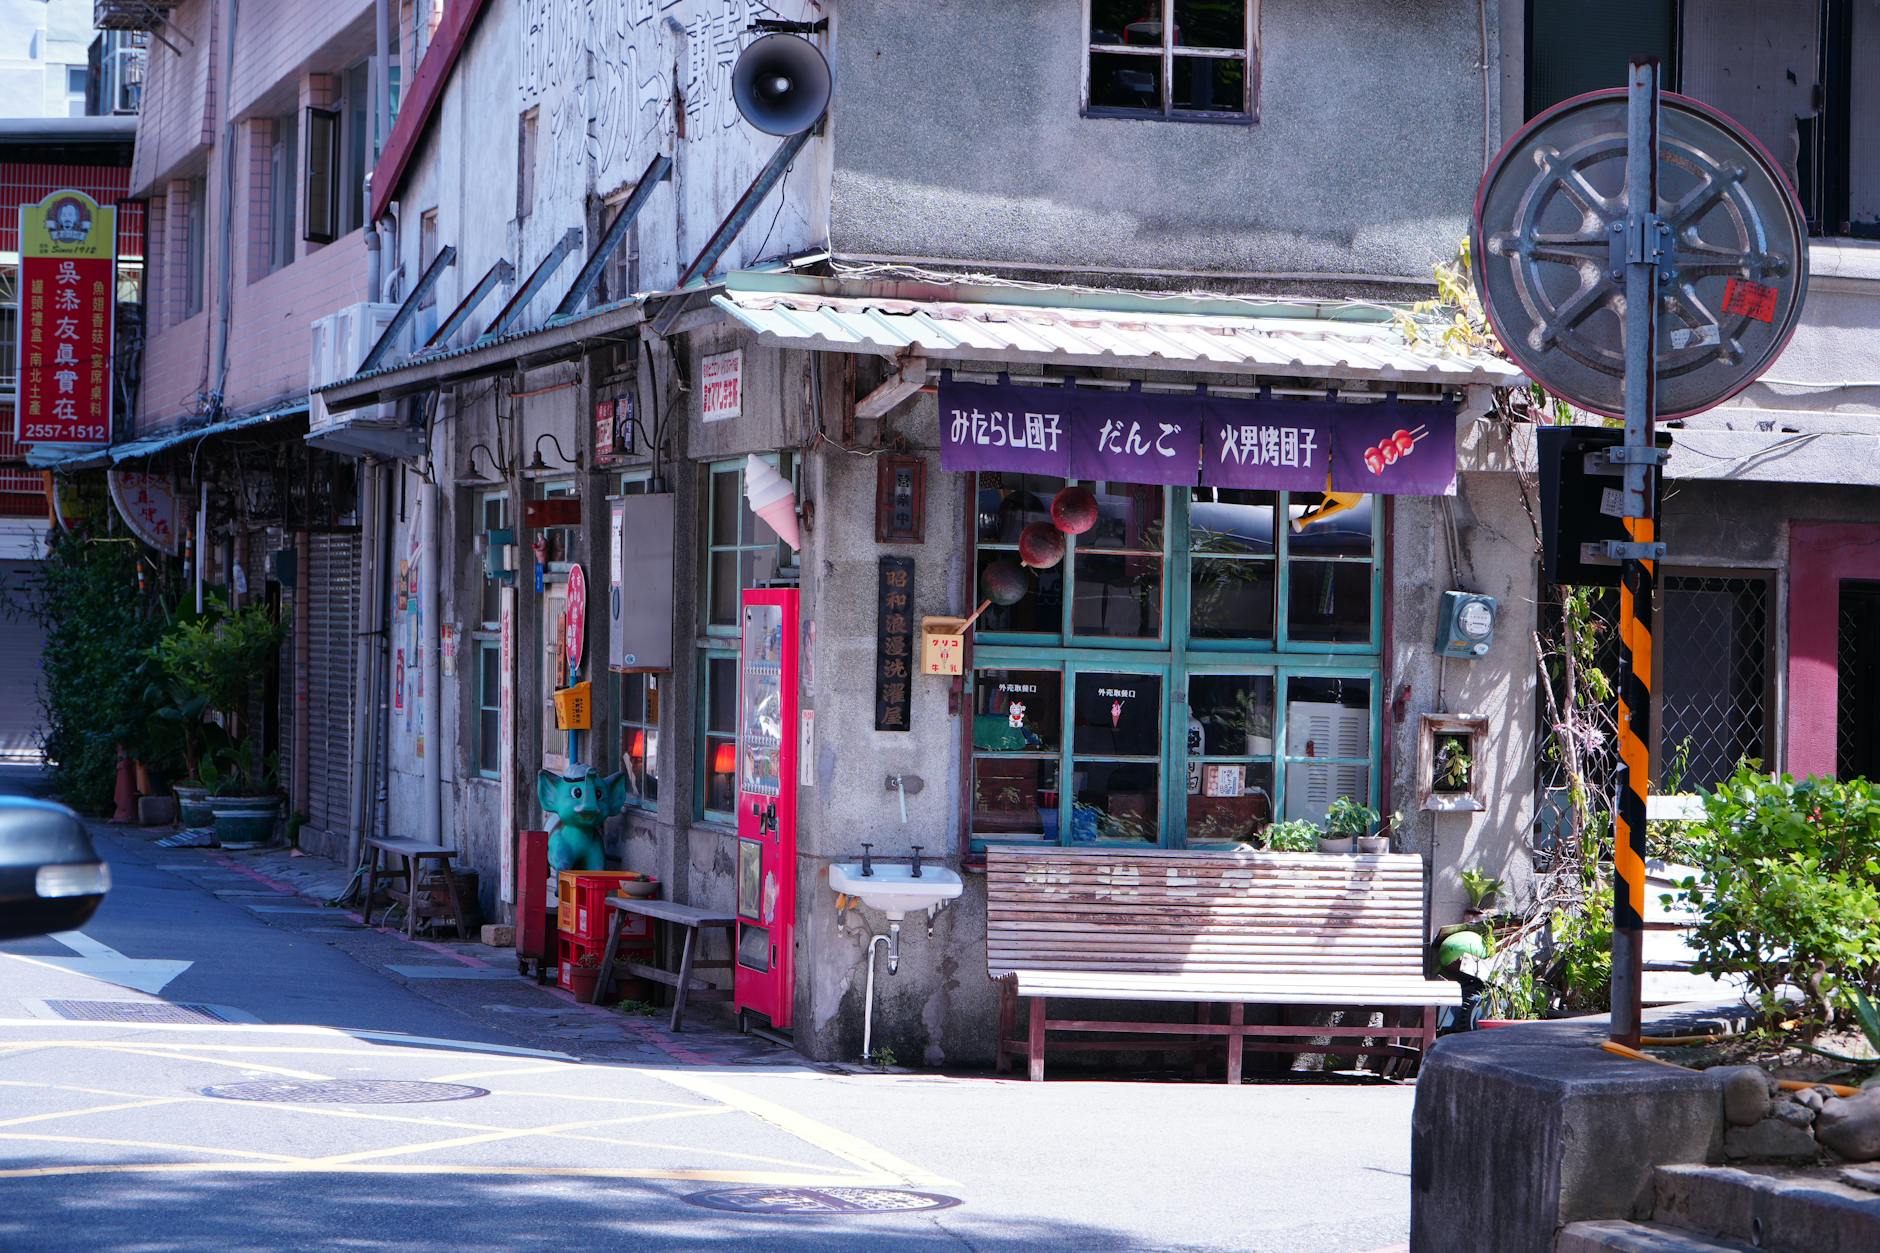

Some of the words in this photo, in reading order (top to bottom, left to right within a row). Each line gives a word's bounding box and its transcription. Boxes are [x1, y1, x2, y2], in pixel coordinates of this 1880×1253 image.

[74, 246, 97, 254] 1912
[26, 424, 104, 439] 2557-1512
[951, 408, 1062, 452] みたらし団子
[1098, 418, 1182, 457] だんご
[1220, 424, 1318, 468] 火男烤団子
